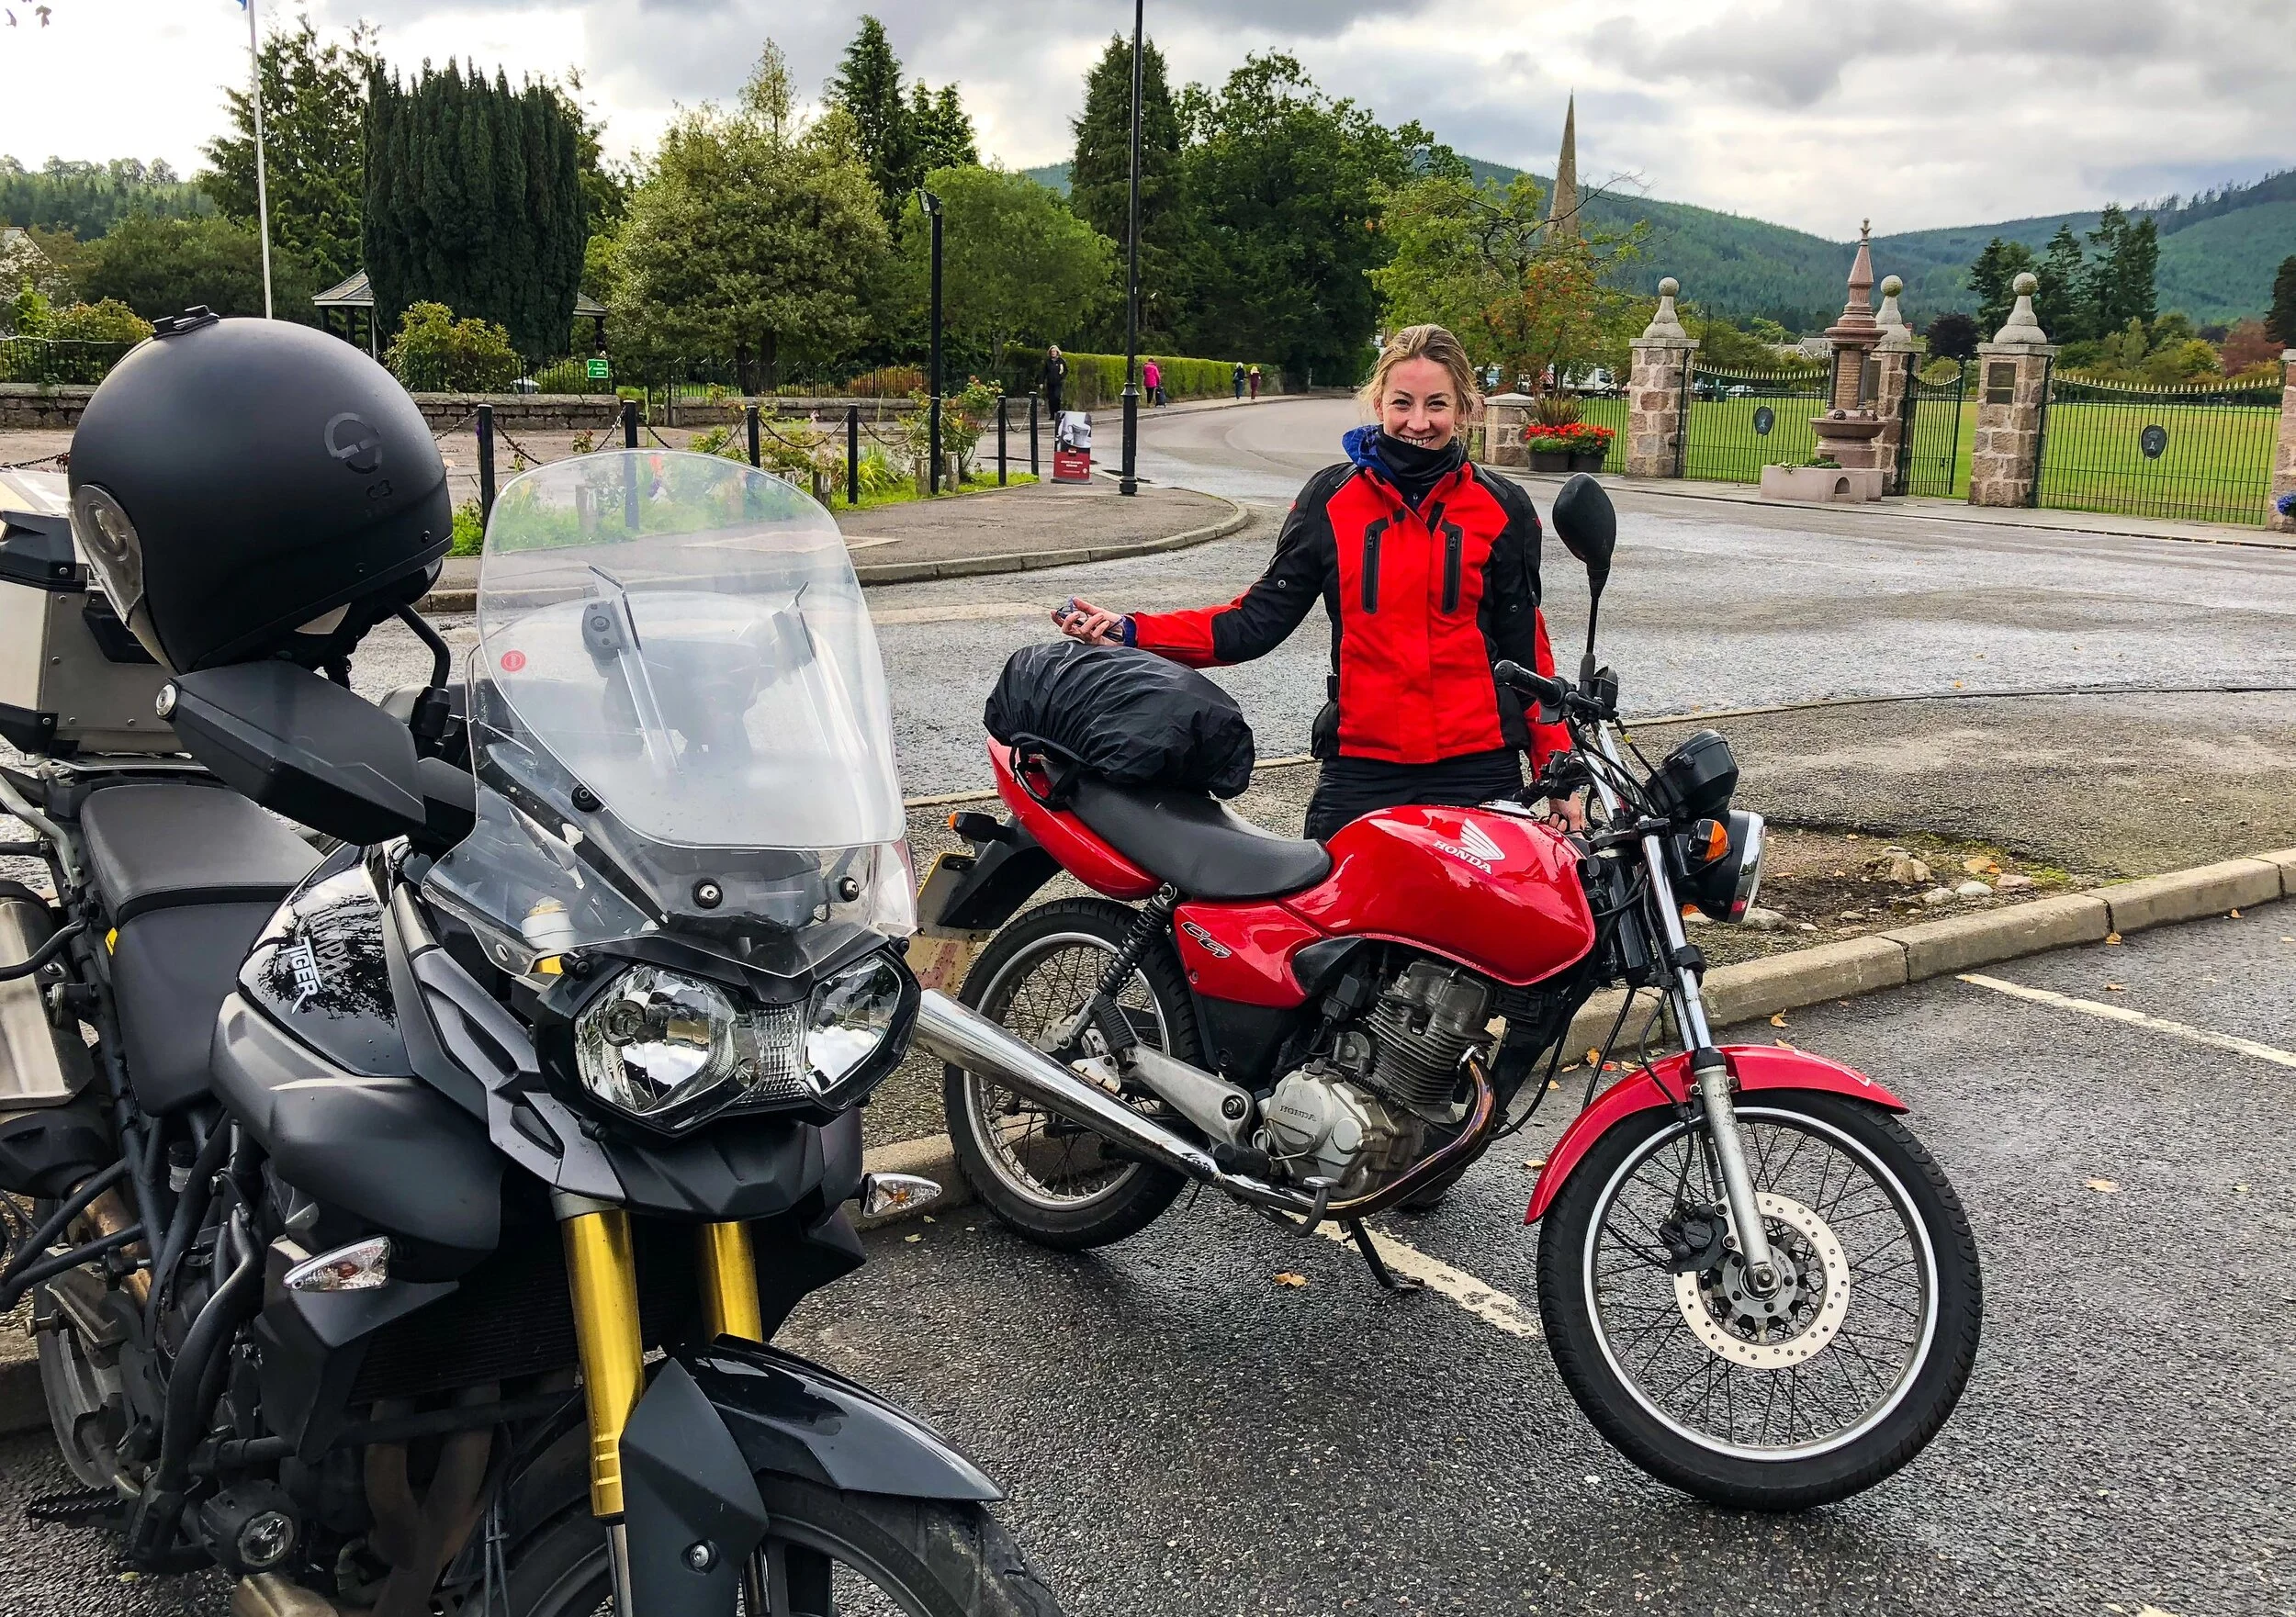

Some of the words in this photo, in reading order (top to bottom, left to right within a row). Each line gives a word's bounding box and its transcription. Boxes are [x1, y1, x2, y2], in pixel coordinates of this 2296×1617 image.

[1433, 839, 1492, 875] HONDA
[276, 936, 323, 1014] TIGER
[1279, 1106, 1317, 1122] HONDA
